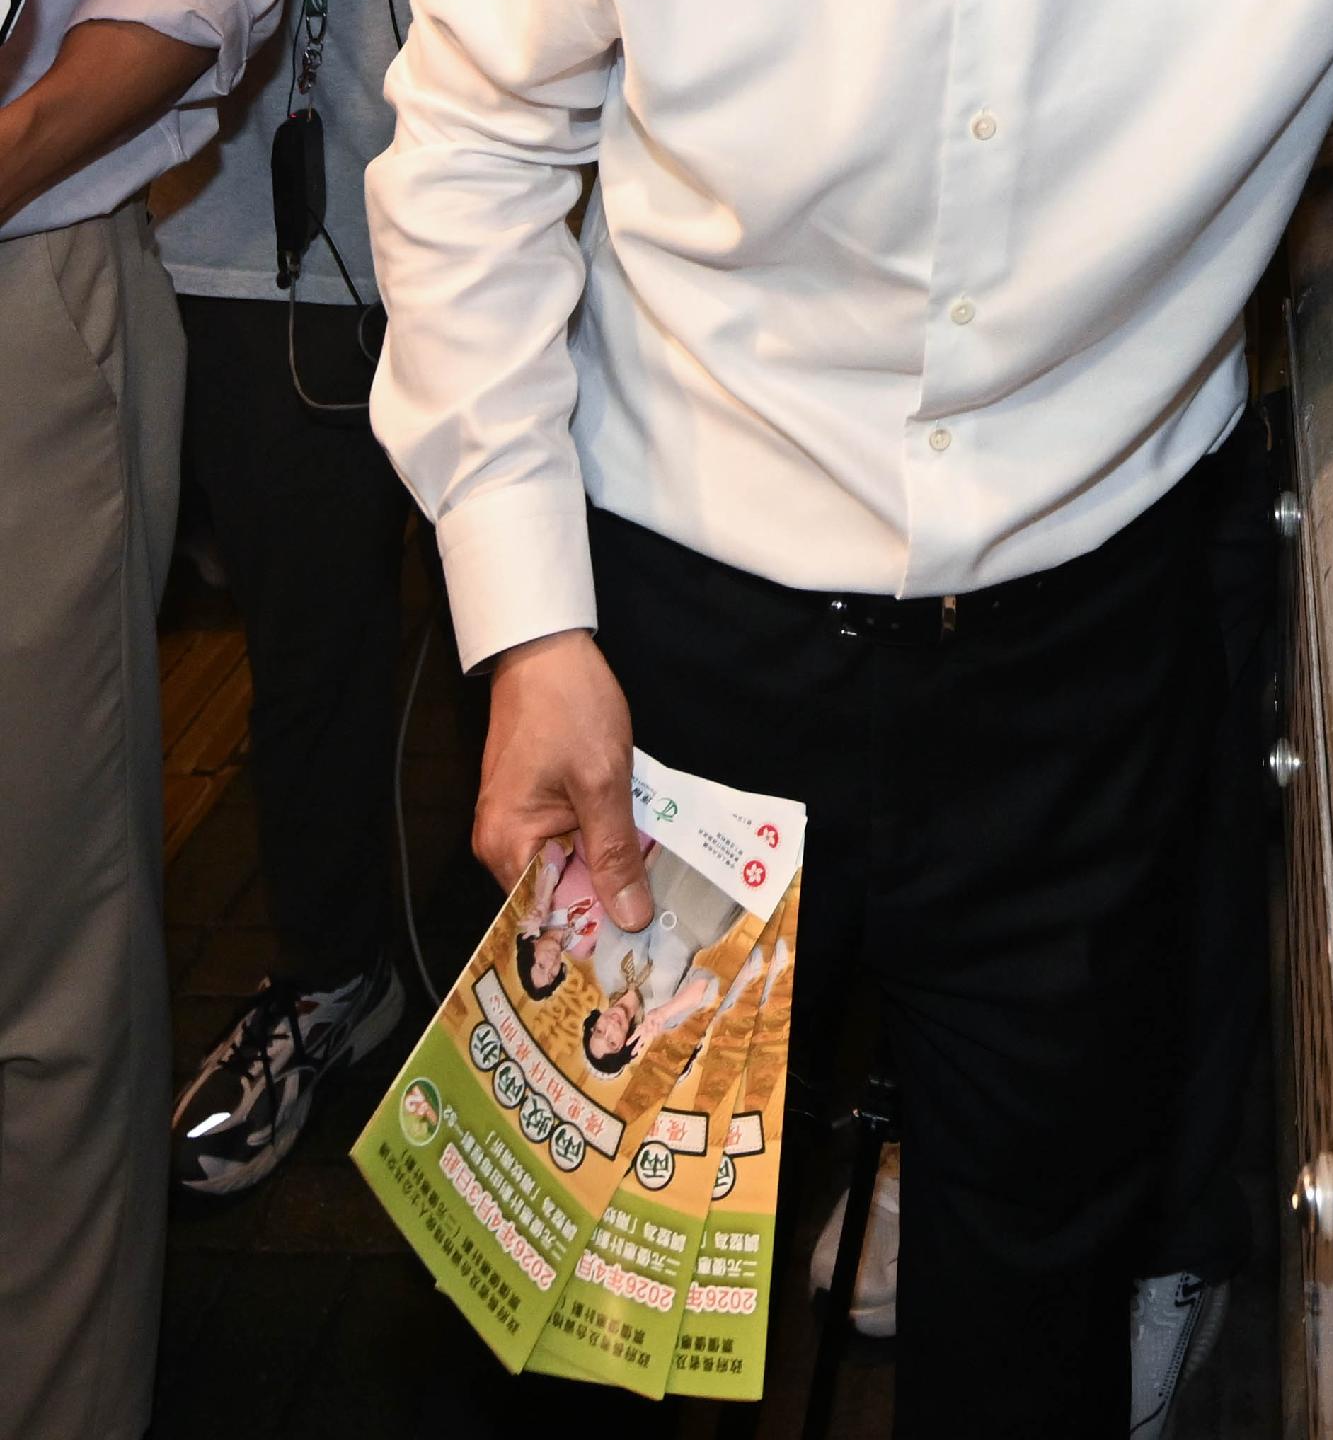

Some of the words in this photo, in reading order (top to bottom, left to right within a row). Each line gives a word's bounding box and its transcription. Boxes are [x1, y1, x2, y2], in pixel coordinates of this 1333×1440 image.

[478, 1030, 583, 1159] 兩蚊兩折
[437, 1142, 556, 1289] 2026年4月3日起
[573, 1248, 675, 1312] 2026年4月
[589, 1225, 680, 1277] 二元優惠計劃
[685, 1280, 756, 1313] 2026年
[674, 1334, 732, 1352] 票價優惠
